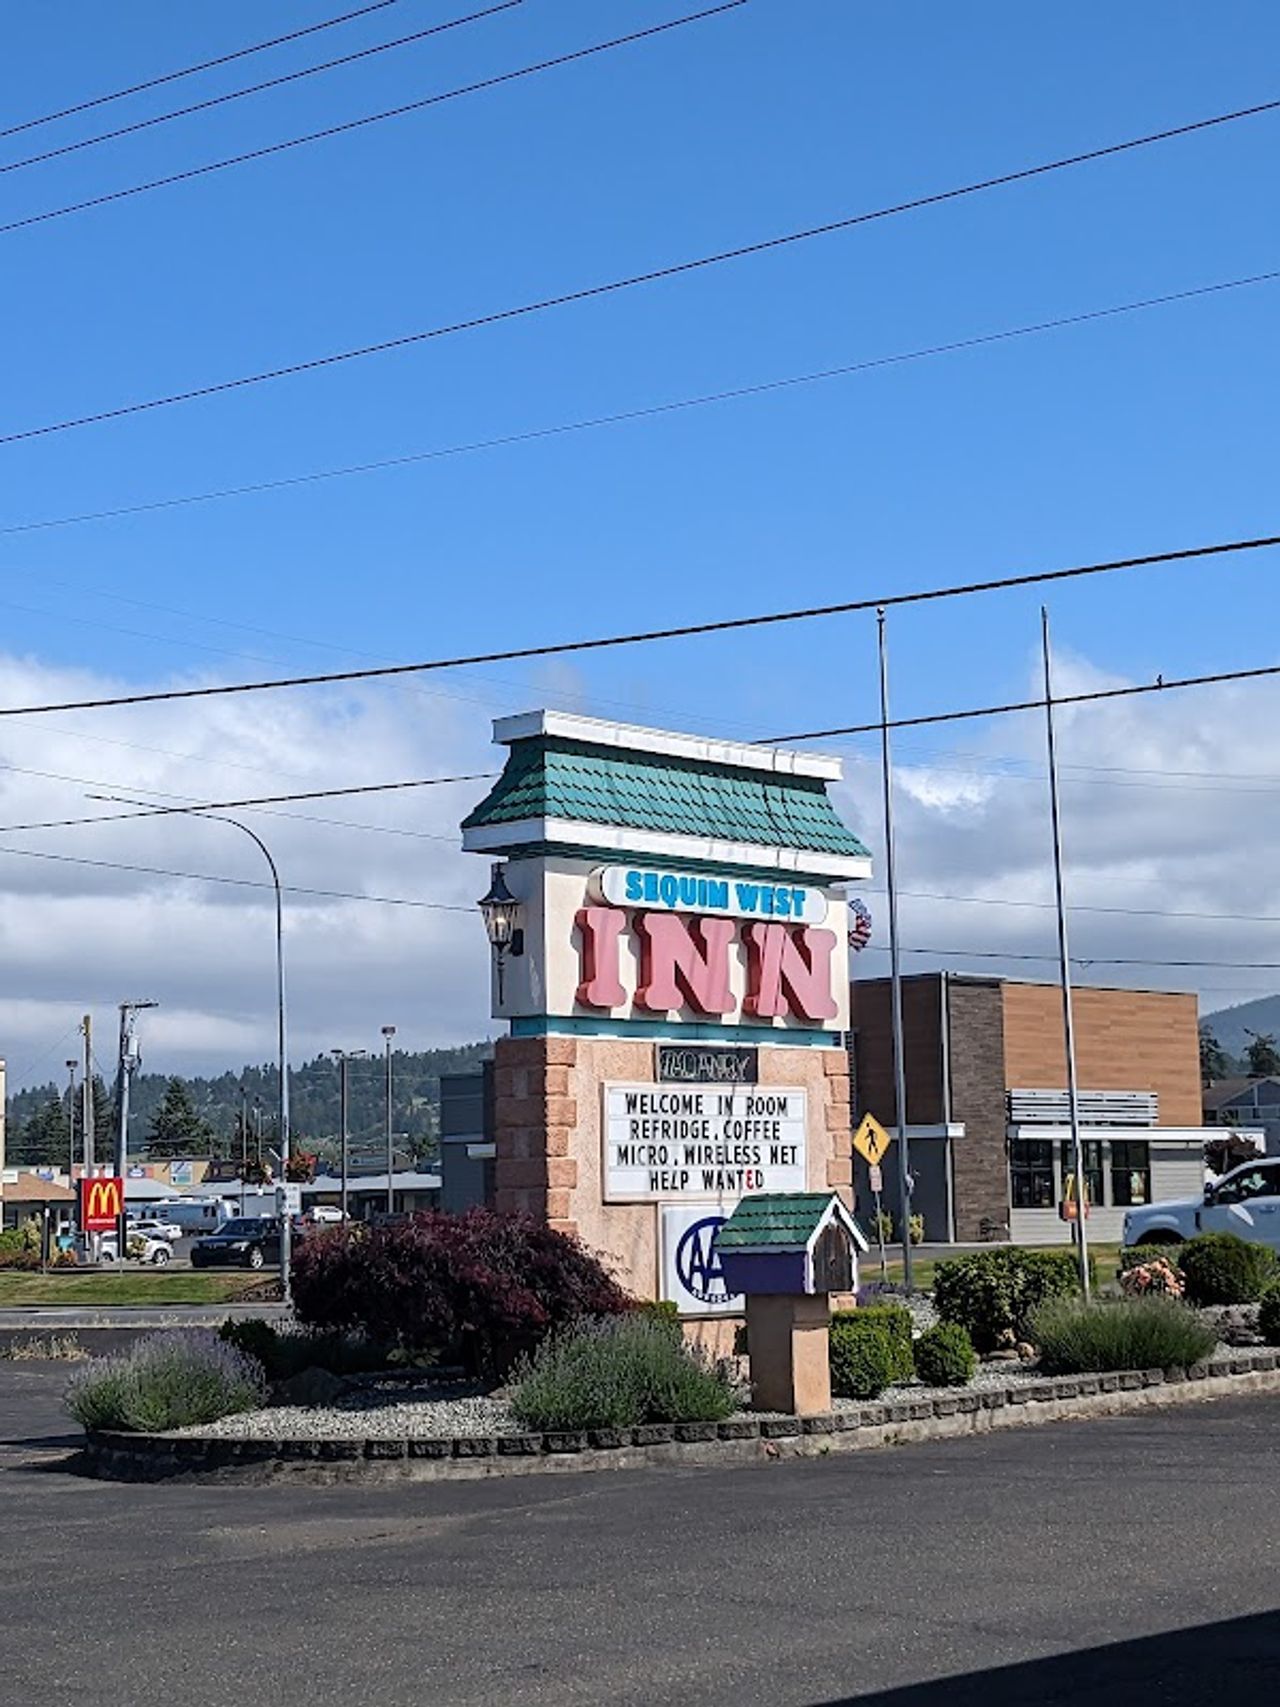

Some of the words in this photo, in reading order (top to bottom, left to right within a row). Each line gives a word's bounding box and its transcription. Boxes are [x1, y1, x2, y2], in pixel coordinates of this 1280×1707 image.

[625, 870, 729, 910] SEQUIM
[735, 883, 806, 917] WEST
[574, 906, 838, 1021] INN
[625, 1093, 704, 1115] WELCOME
[718, 1095, 734, 1115] IN
[747, 1096, 788, 1116] ROOM
[770, 1146, 798, 1165] NET
[650, 1169, 689, 1191] HELP
[702, 1169, 765, 1190] WANTED
